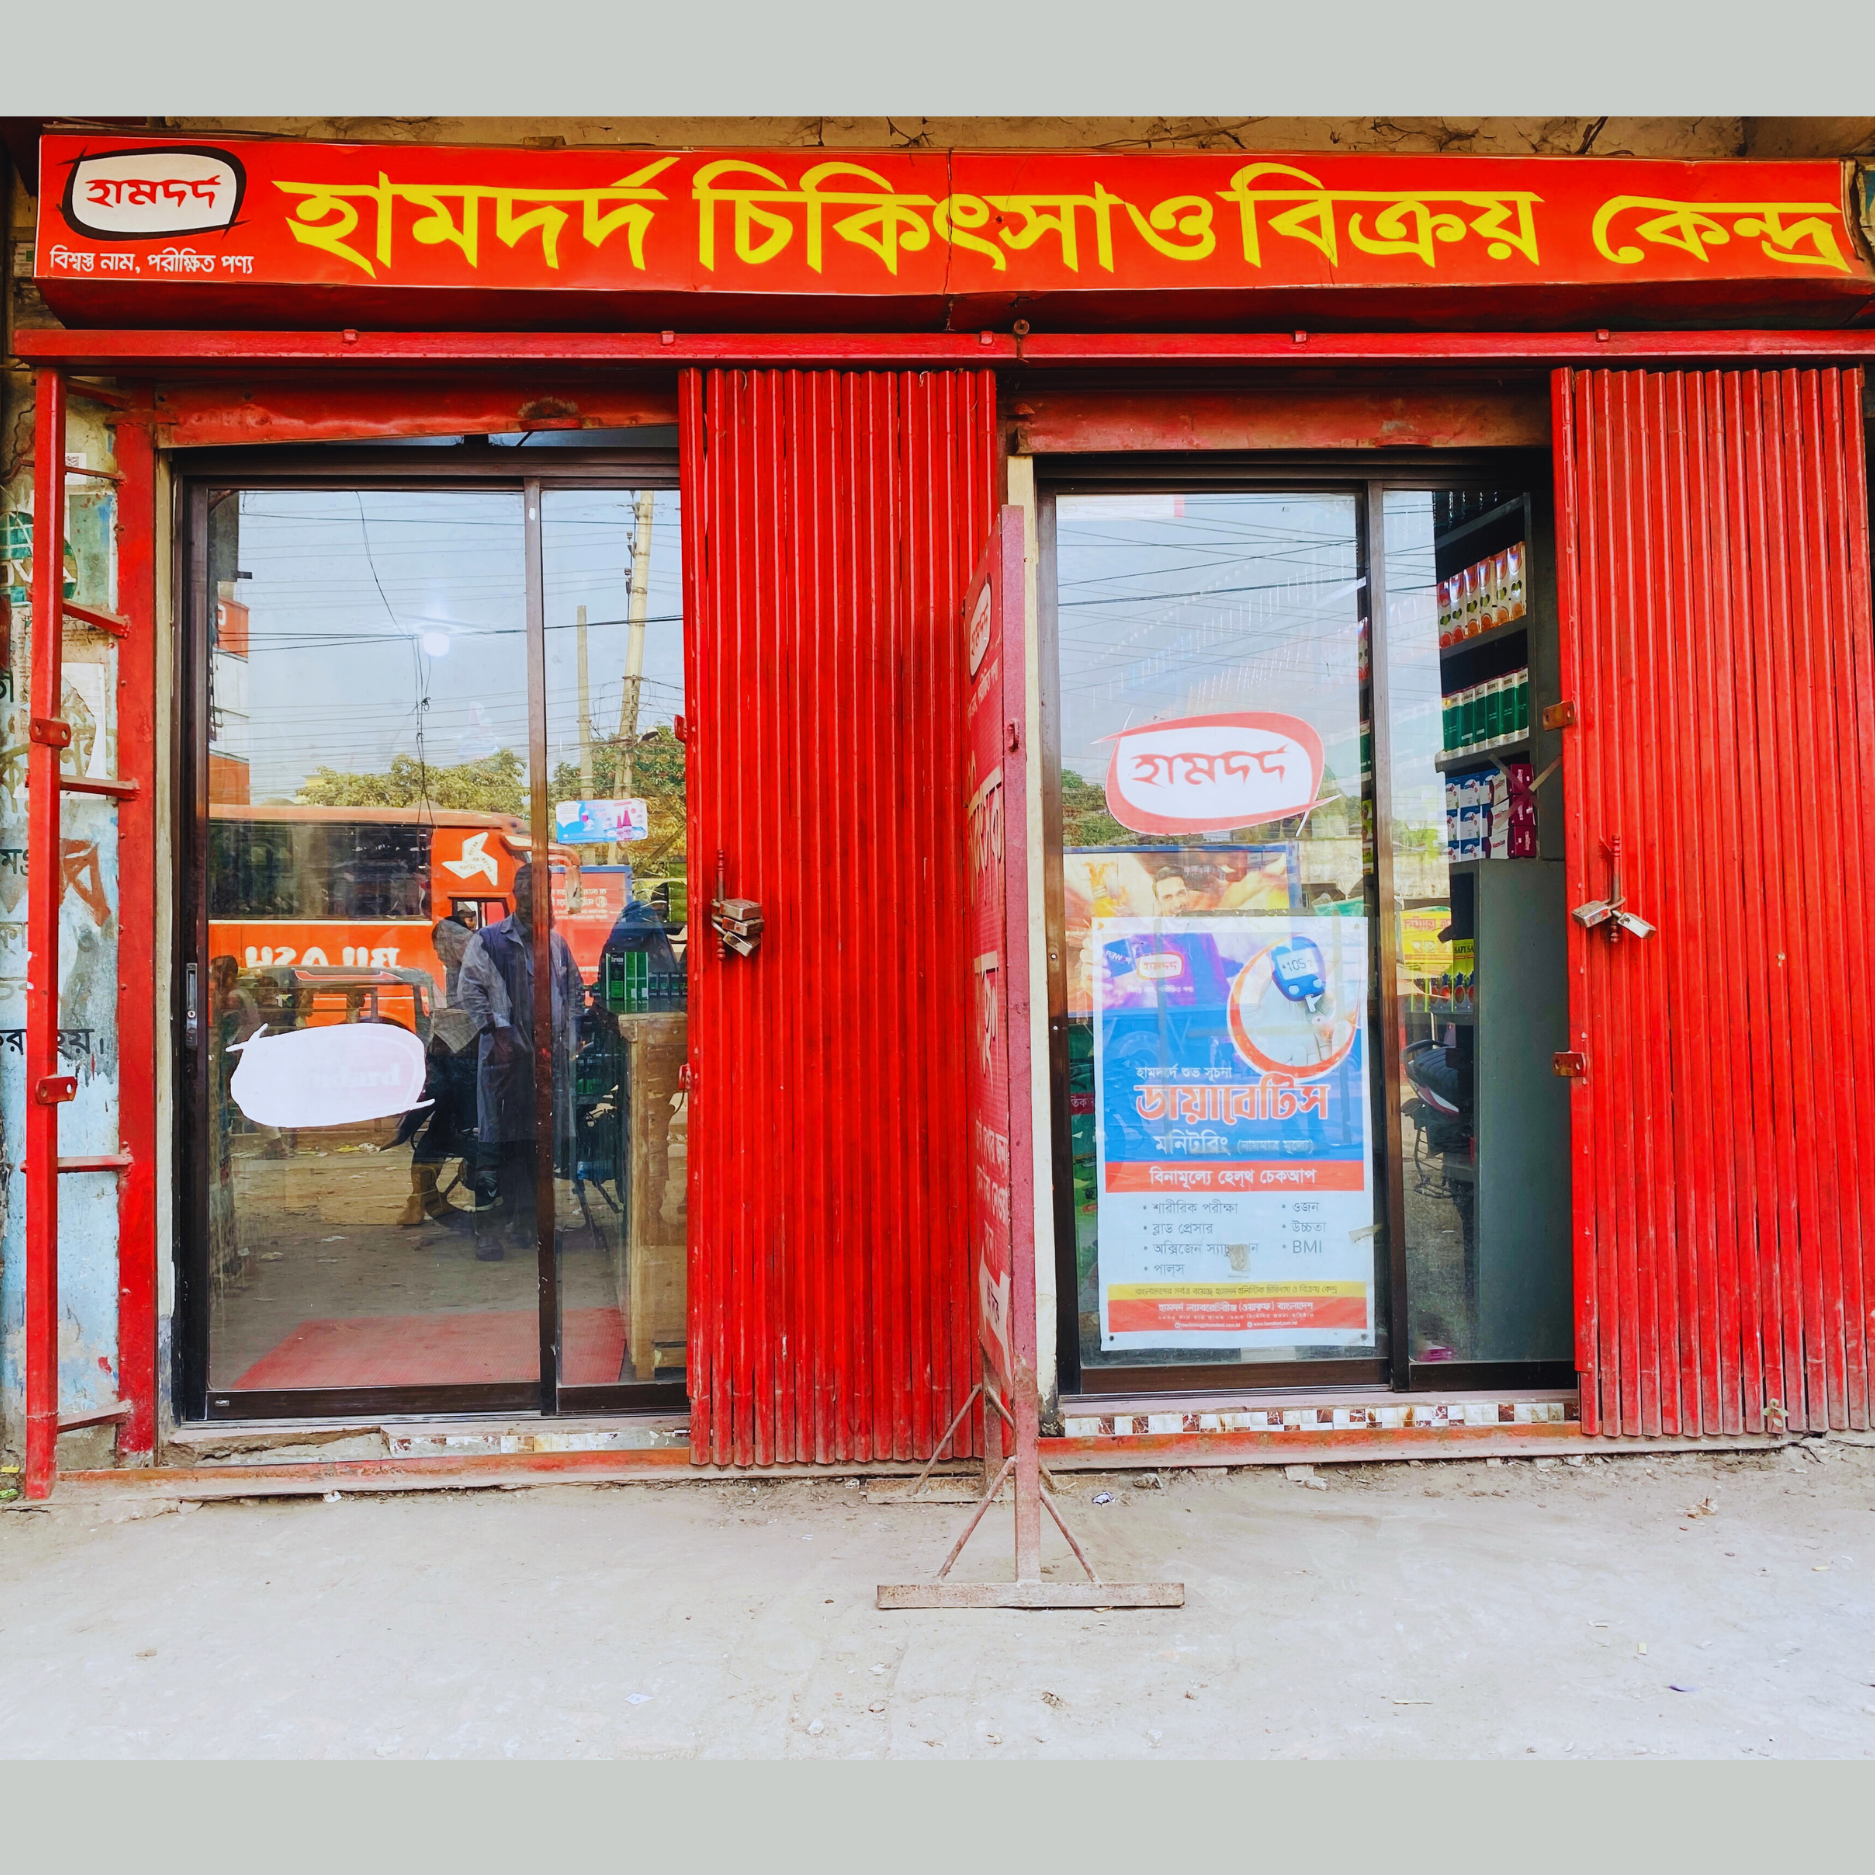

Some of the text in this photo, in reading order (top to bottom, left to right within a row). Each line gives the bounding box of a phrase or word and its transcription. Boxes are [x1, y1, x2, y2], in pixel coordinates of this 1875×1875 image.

[85, 174, 221, 208] হামদর্দ
[272, 156, 681, 279] হামদর্দ
[1592, 194, 1853, 274] কেন্দ্র
[49, 244, 95, 272] বিশ্বস্ত
[100, 253, 141, 274] নাম,
[147, 247, 216, 273] পরীক্ষিত
[221, 255, 254, 274] পণ্য
[1130, 743, 1290, 788] হামদর্দ
[1286, 957, 1307, 972] 105
[1135, 1063, 1233, 1082] হামদর্দে শুভ সূচনা
[1134, 1071, 1330, 1125] ডায়াবেটিস
[1152, 1129, 1231, 1156] মনিটরিং
[1149, 1166, 1213, 1189] বিনামূল্যে
[1259, 1168, 1317, 1184] চেকআপ
[1152, 1199, 1238, 1214] শারীরিক পরীক্ষা
[1292, 1202, 1320, 1213] ওজন
[1152, 1223, 1213, 1236] ব্লাড প্রেসার
[1291, 1220, 1326, 1233] উচ্চতা
[1152, 1239, 1259, 1258] অক্সিজেন স্যাচুন
[1293, 1240, 1322, 1254] BMI
[1276, 1301, 1313, 1310] বাংলাদেশ
